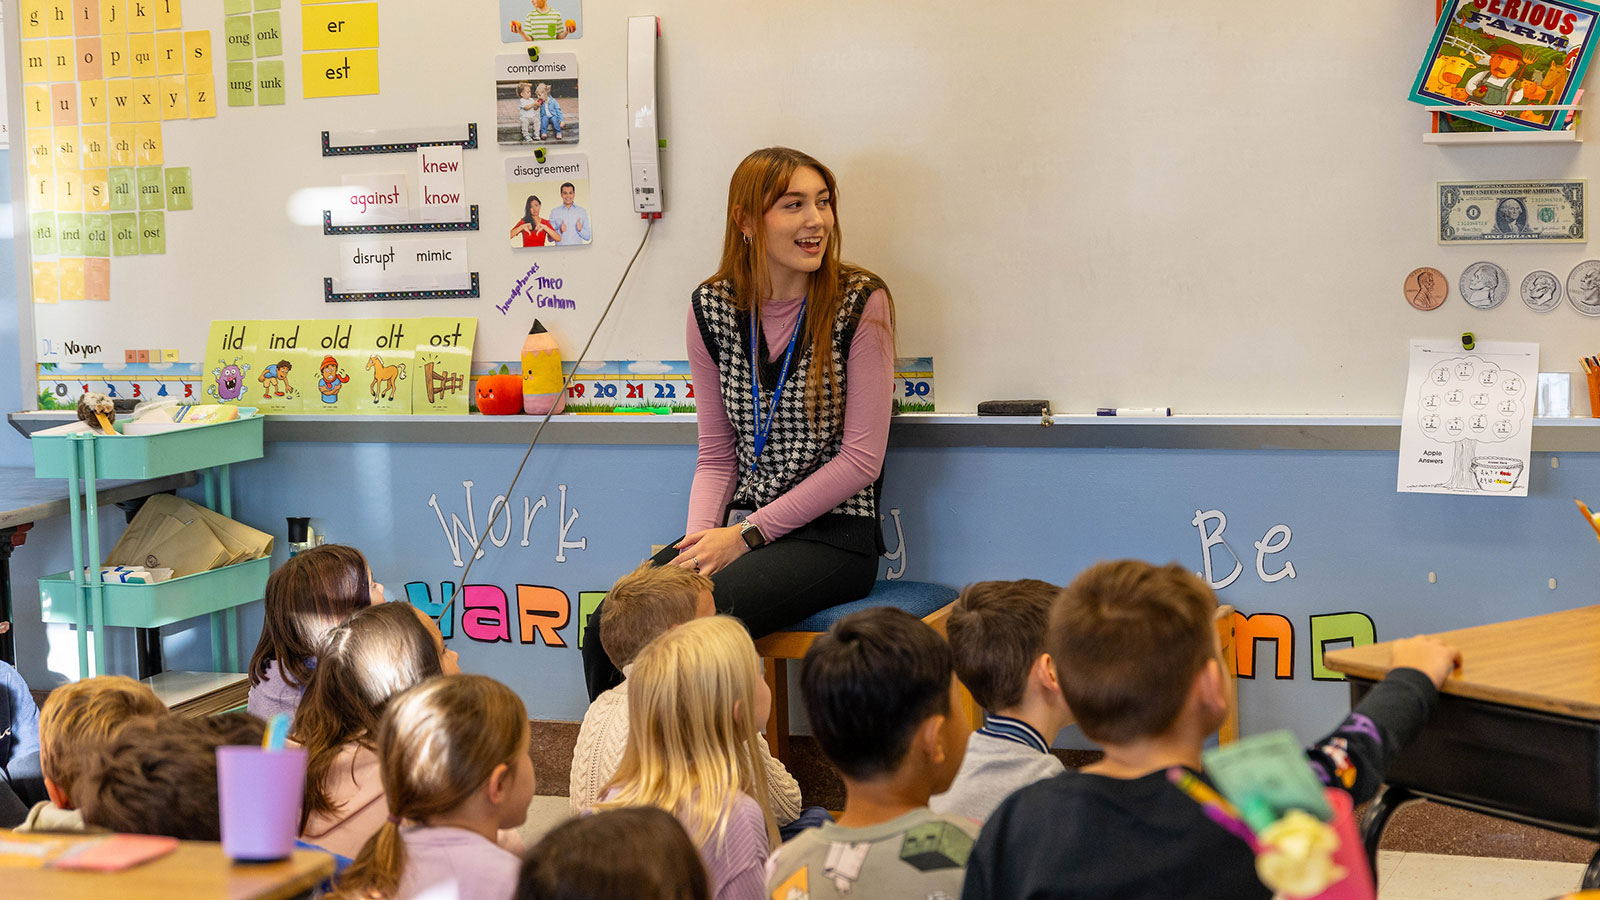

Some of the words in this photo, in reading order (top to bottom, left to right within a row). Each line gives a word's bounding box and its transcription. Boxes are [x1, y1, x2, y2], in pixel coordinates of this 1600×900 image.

[30, 11, 39, 26] g
[55, 7, 64, 20] h
[84, 7, 89, 20] i
[110, 6, 116, 22] j
[136, 3, 145, 17] k
[257, 28, 279, 41] onk
[327, 20, 345, 32] er
[1470, 11, 1569, 48] FARM
[228, 33, 250, 47] ong
[29, 56, 42, 68] m
[57, 55, 66, 66] n
[84, 53, 93, 64] o
[111, 50, 120, 65] p
[136, 52, 150, 64] qu
[166, 49, 173, 59] r
[195, 47, 203, 58] s
[326, 57, 350, 80] est
[507, 62, 566, 76] compromise
[230, 80, 252, 93] ung
[260, 77, 282, 90] unk
[36, 100, 40, 112] t
[60, 100, 69, 110] u
[90, 97, 98, 107] v
[115, 96, 128, 107] w
[142, 94, 151, 105] x
[170, 92, 178, 108] y
[198, 91, 206, 103] z
[32, 144, 48, 156] wh
[60, 142, 73, 153] sh
[90, 141, 101, 152] th
[116, 140, 129, 151] ch
[143, 138, 156, 150] ck
[422, 154, 458, 173] knew
[514, 164, 580, 178] disagreement
[40, 180, 46, 194] f
[92, 186, 100, 196] s
[115, 183, 129, 194] all
[142, 184, 159, 194] am
[172, 185, 185, 195] an
[424, 185, 460, 205] know
[350, 185, 399, 213] against
[37, 227, 51, 239] ild
[62, 229, 80, 240] ind
[88, 230, 106, 241] old
[118, 229, 132, 240] olt
[144, 228, 160, 238] ost
[353, 246, 395, 271] disrupt
[416, 250, 452, 262] mimic
[535, 276, 563, 290] Theo
[537, 294, 576, 310] Graham
[222, 326, 246, 350] ild
[270, 325, 300, 349] ind
[321, 325, 352, 349] old
[376, 324, 404, 348] olt
[430, 323, 462, 347] ost
[56, 383, 68, 396] 0
[108, 384, 116, 398] 2
[134, 384, 141, 398] 3
[157, 384, 168, 396] 4
[185, 384, 192, 398] 5
[567, 383, 584, 398] 19
[594, 383, 617, 398] 20
[626, 384, 643, 398] 21
[654, 383, 676, 398] 22
[905, 382, 930, 397] 30
[428, 480, 587, 568] Work
[1192, 509, 1296, 590] Be
